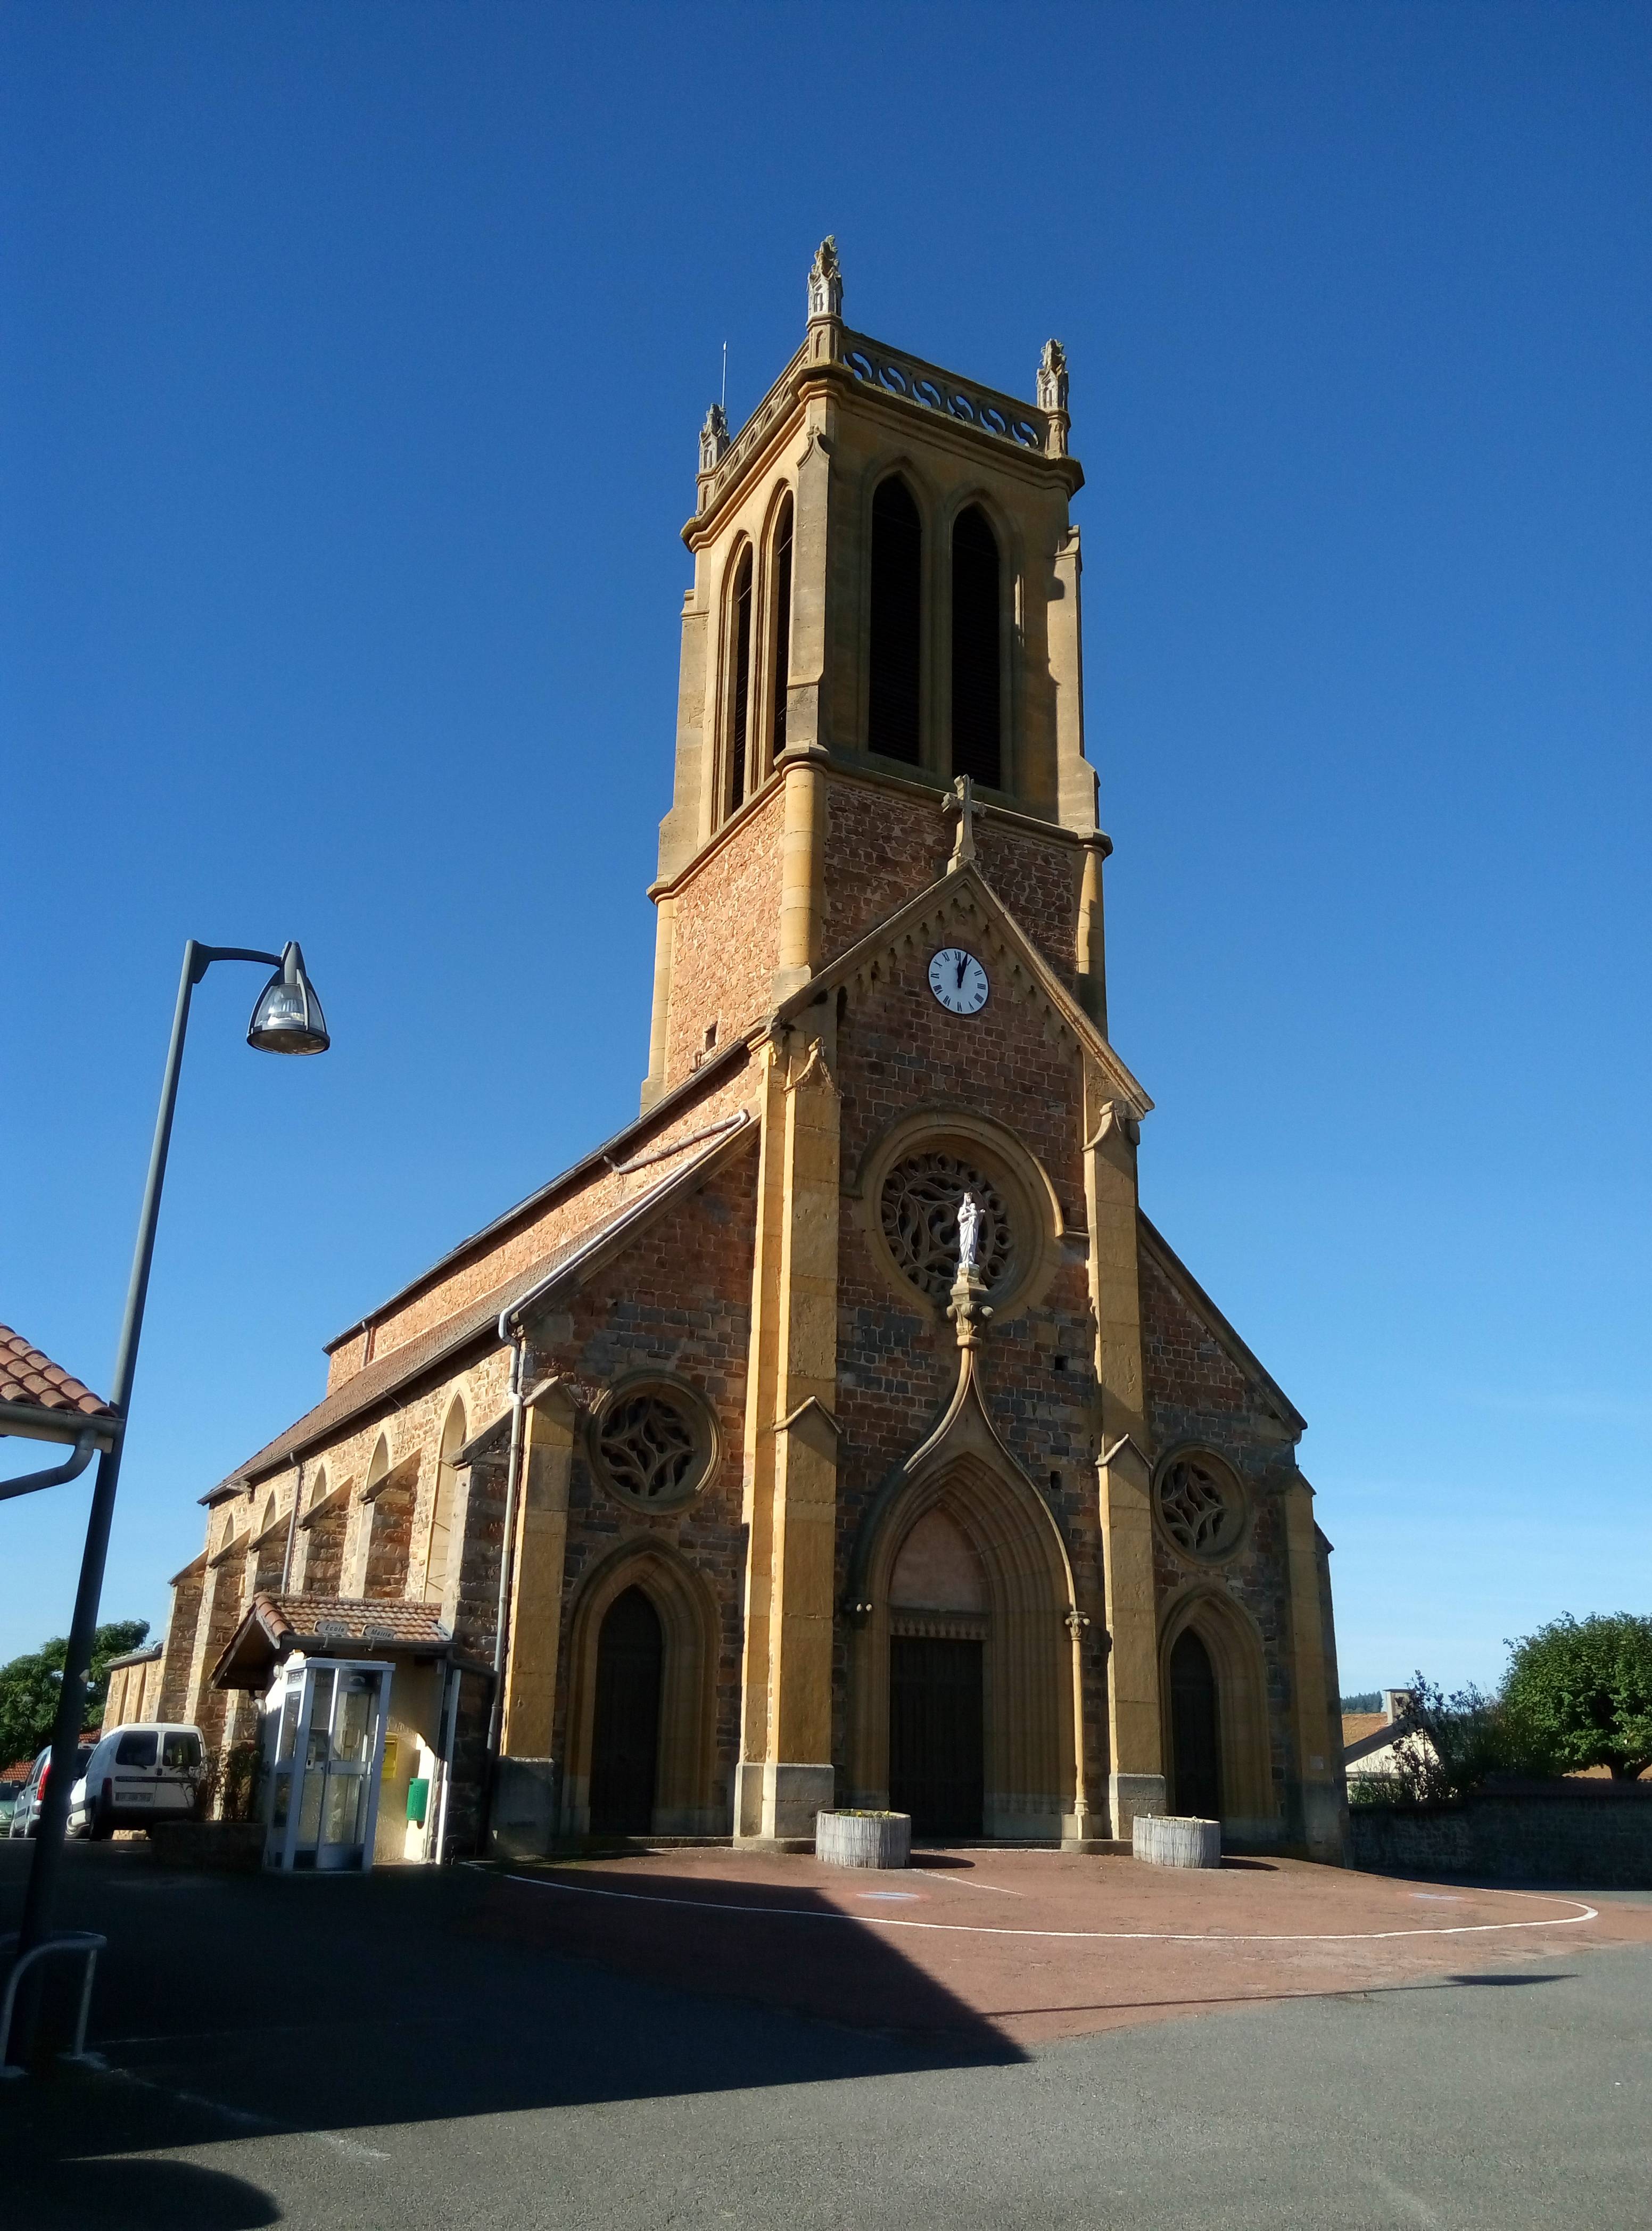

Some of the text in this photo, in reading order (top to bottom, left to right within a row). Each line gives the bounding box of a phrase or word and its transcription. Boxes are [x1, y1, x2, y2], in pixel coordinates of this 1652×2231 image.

[941, 952, 950, 962] XI
[934, 959, 943, 969] X
[957, 1002, 963, 1012] VI
[968, 1001, 974, 1011] V
[325, 1623, 345, 1632] École
[370, 1629, 392, 1638] Mairie
